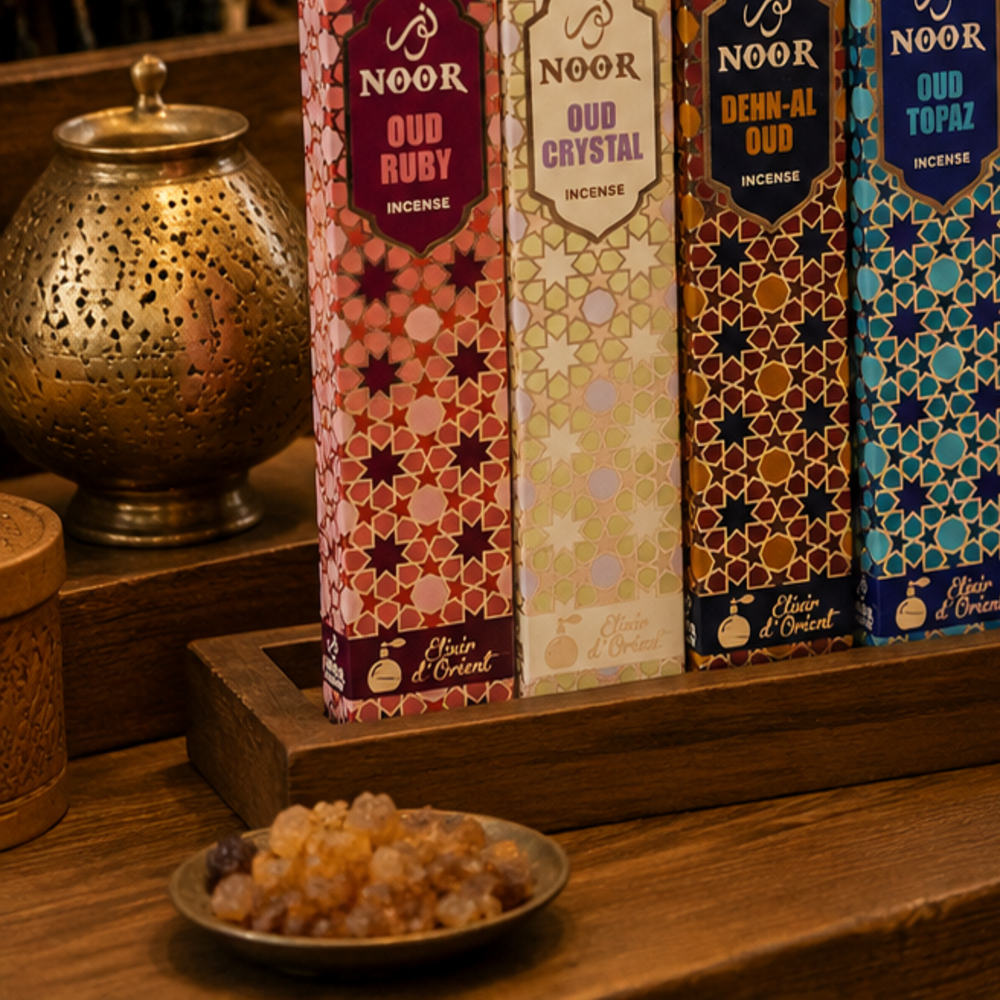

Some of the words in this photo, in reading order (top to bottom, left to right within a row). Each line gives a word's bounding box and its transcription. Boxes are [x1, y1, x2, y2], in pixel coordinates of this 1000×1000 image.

[717, 39, 820, 73] NOOR
[890, 22, 987, 56] NOOR
[359, 62, 469, 97] NOOR
[538, 52, 642, 86] NOOR
[917, 70, 964, 102] OUD
[567, 101, 617, 133] OUD
[721, 87, 817, 125] DEHN-AL
[906, 100, 975, 136] TOPAZ
[387, 112, 443, 149] OUD
[745, 123, 794, 156] OUD
[380, 147, 453, 185] RUBY
[541, 132, 644, 169] CRYSTAL
[914, 151, 971, 170] INCENSE
[565, 183, 625, 201] INCENSE
[741, 170, 801, 187] INCENSE
[387, 197, 451, 215] INCENSE
